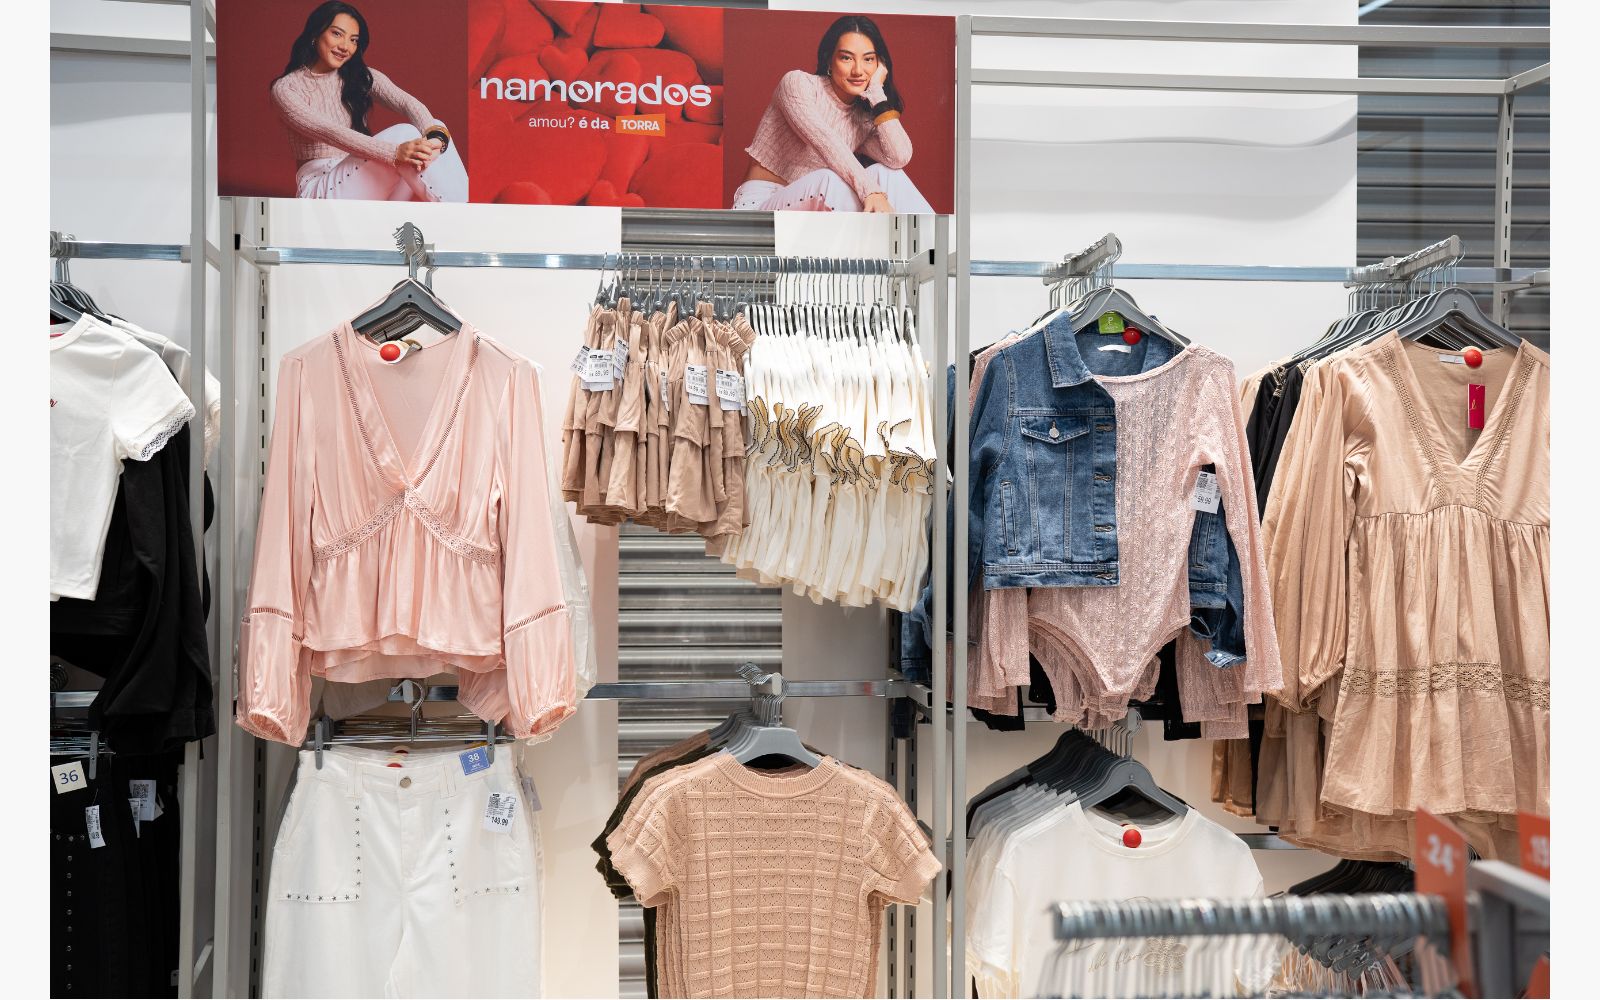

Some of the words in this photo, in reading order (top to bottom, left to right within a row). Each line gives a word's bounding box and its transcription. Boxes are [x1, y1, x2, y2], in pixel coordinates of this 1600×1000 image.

[480, 75, 712, 107] namorados
[528, 115, 575, 128] amou?
[578, 116, 588, 129] é
[590, 116, 610, 130] da
[620, 118, 661, 131] TORRA
[468, 753, 480, 763] 38
[59, 769, 79, 785] 36
[1427, 834, 1454, 877] 24
